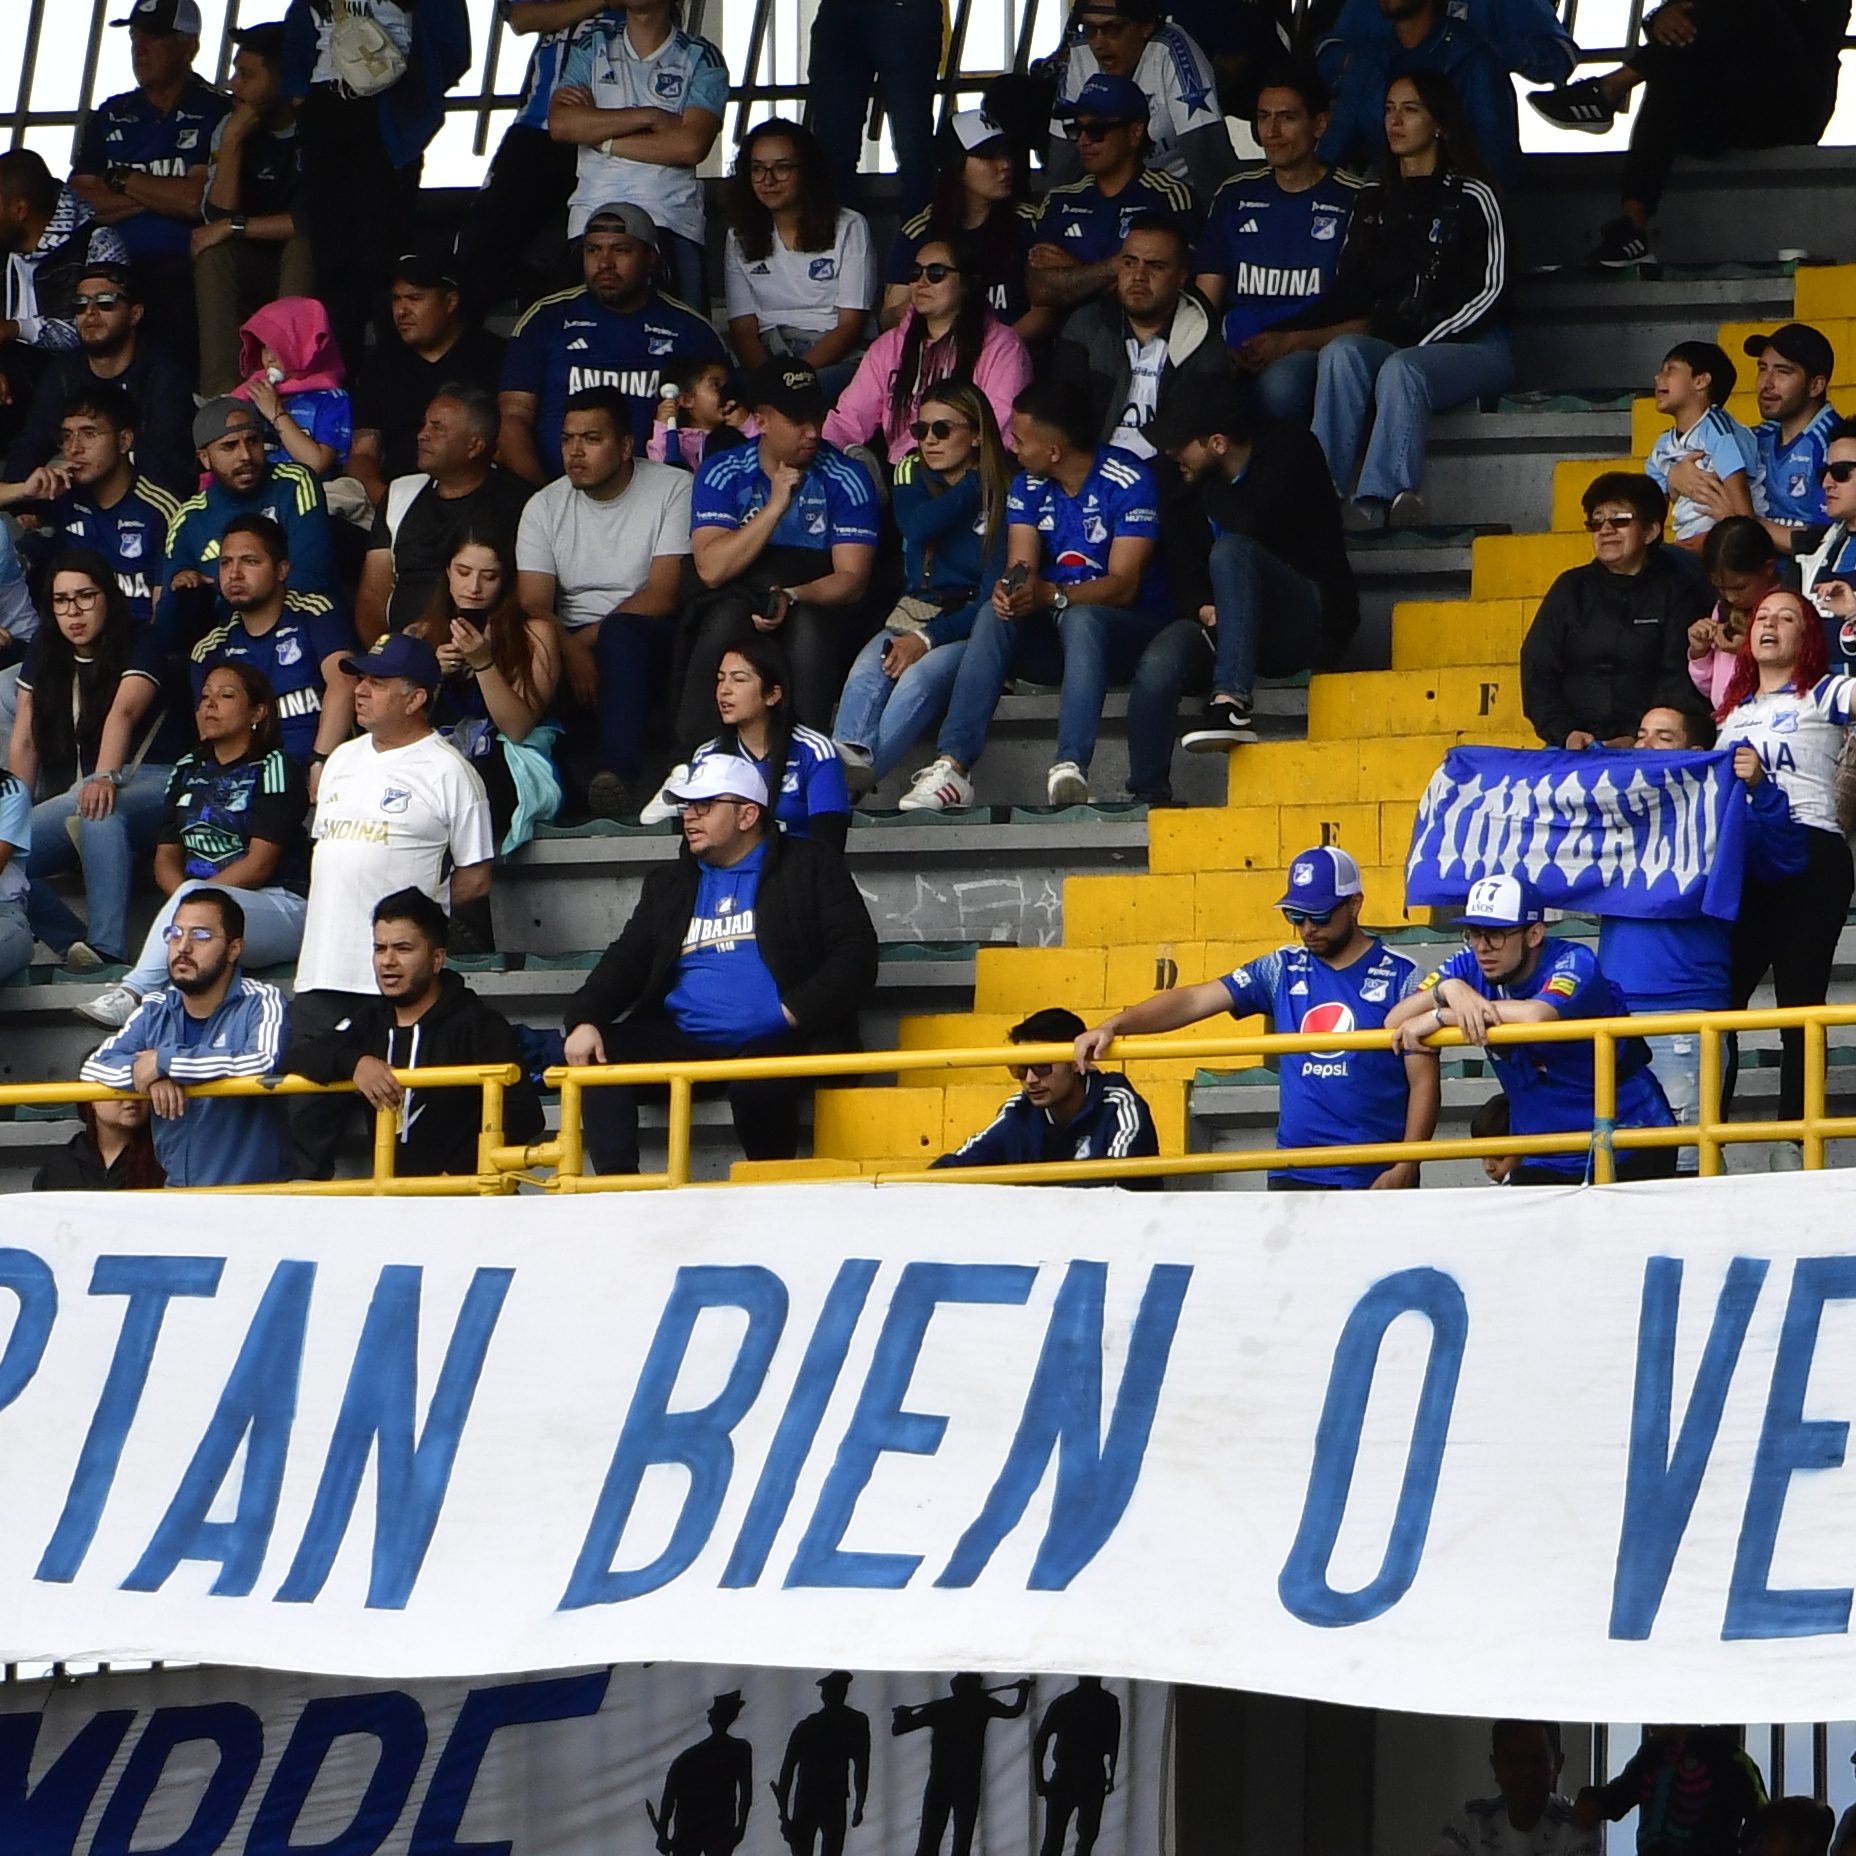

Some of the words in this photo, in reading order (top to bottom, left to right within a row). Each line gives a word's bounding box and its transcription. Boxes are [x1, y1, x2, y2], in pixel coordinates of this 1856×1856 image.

[1236, 261, 1321, 297] ANDINA
[568, 365, 661, 395] ANDINA
[683, 910, 758, 949] MBAJAD
[1301, 1061, 1349, 1079] pepsi
[559, 1257, 1194, 1612] BIEN
[1276, 1266, 1471, 1630] O
